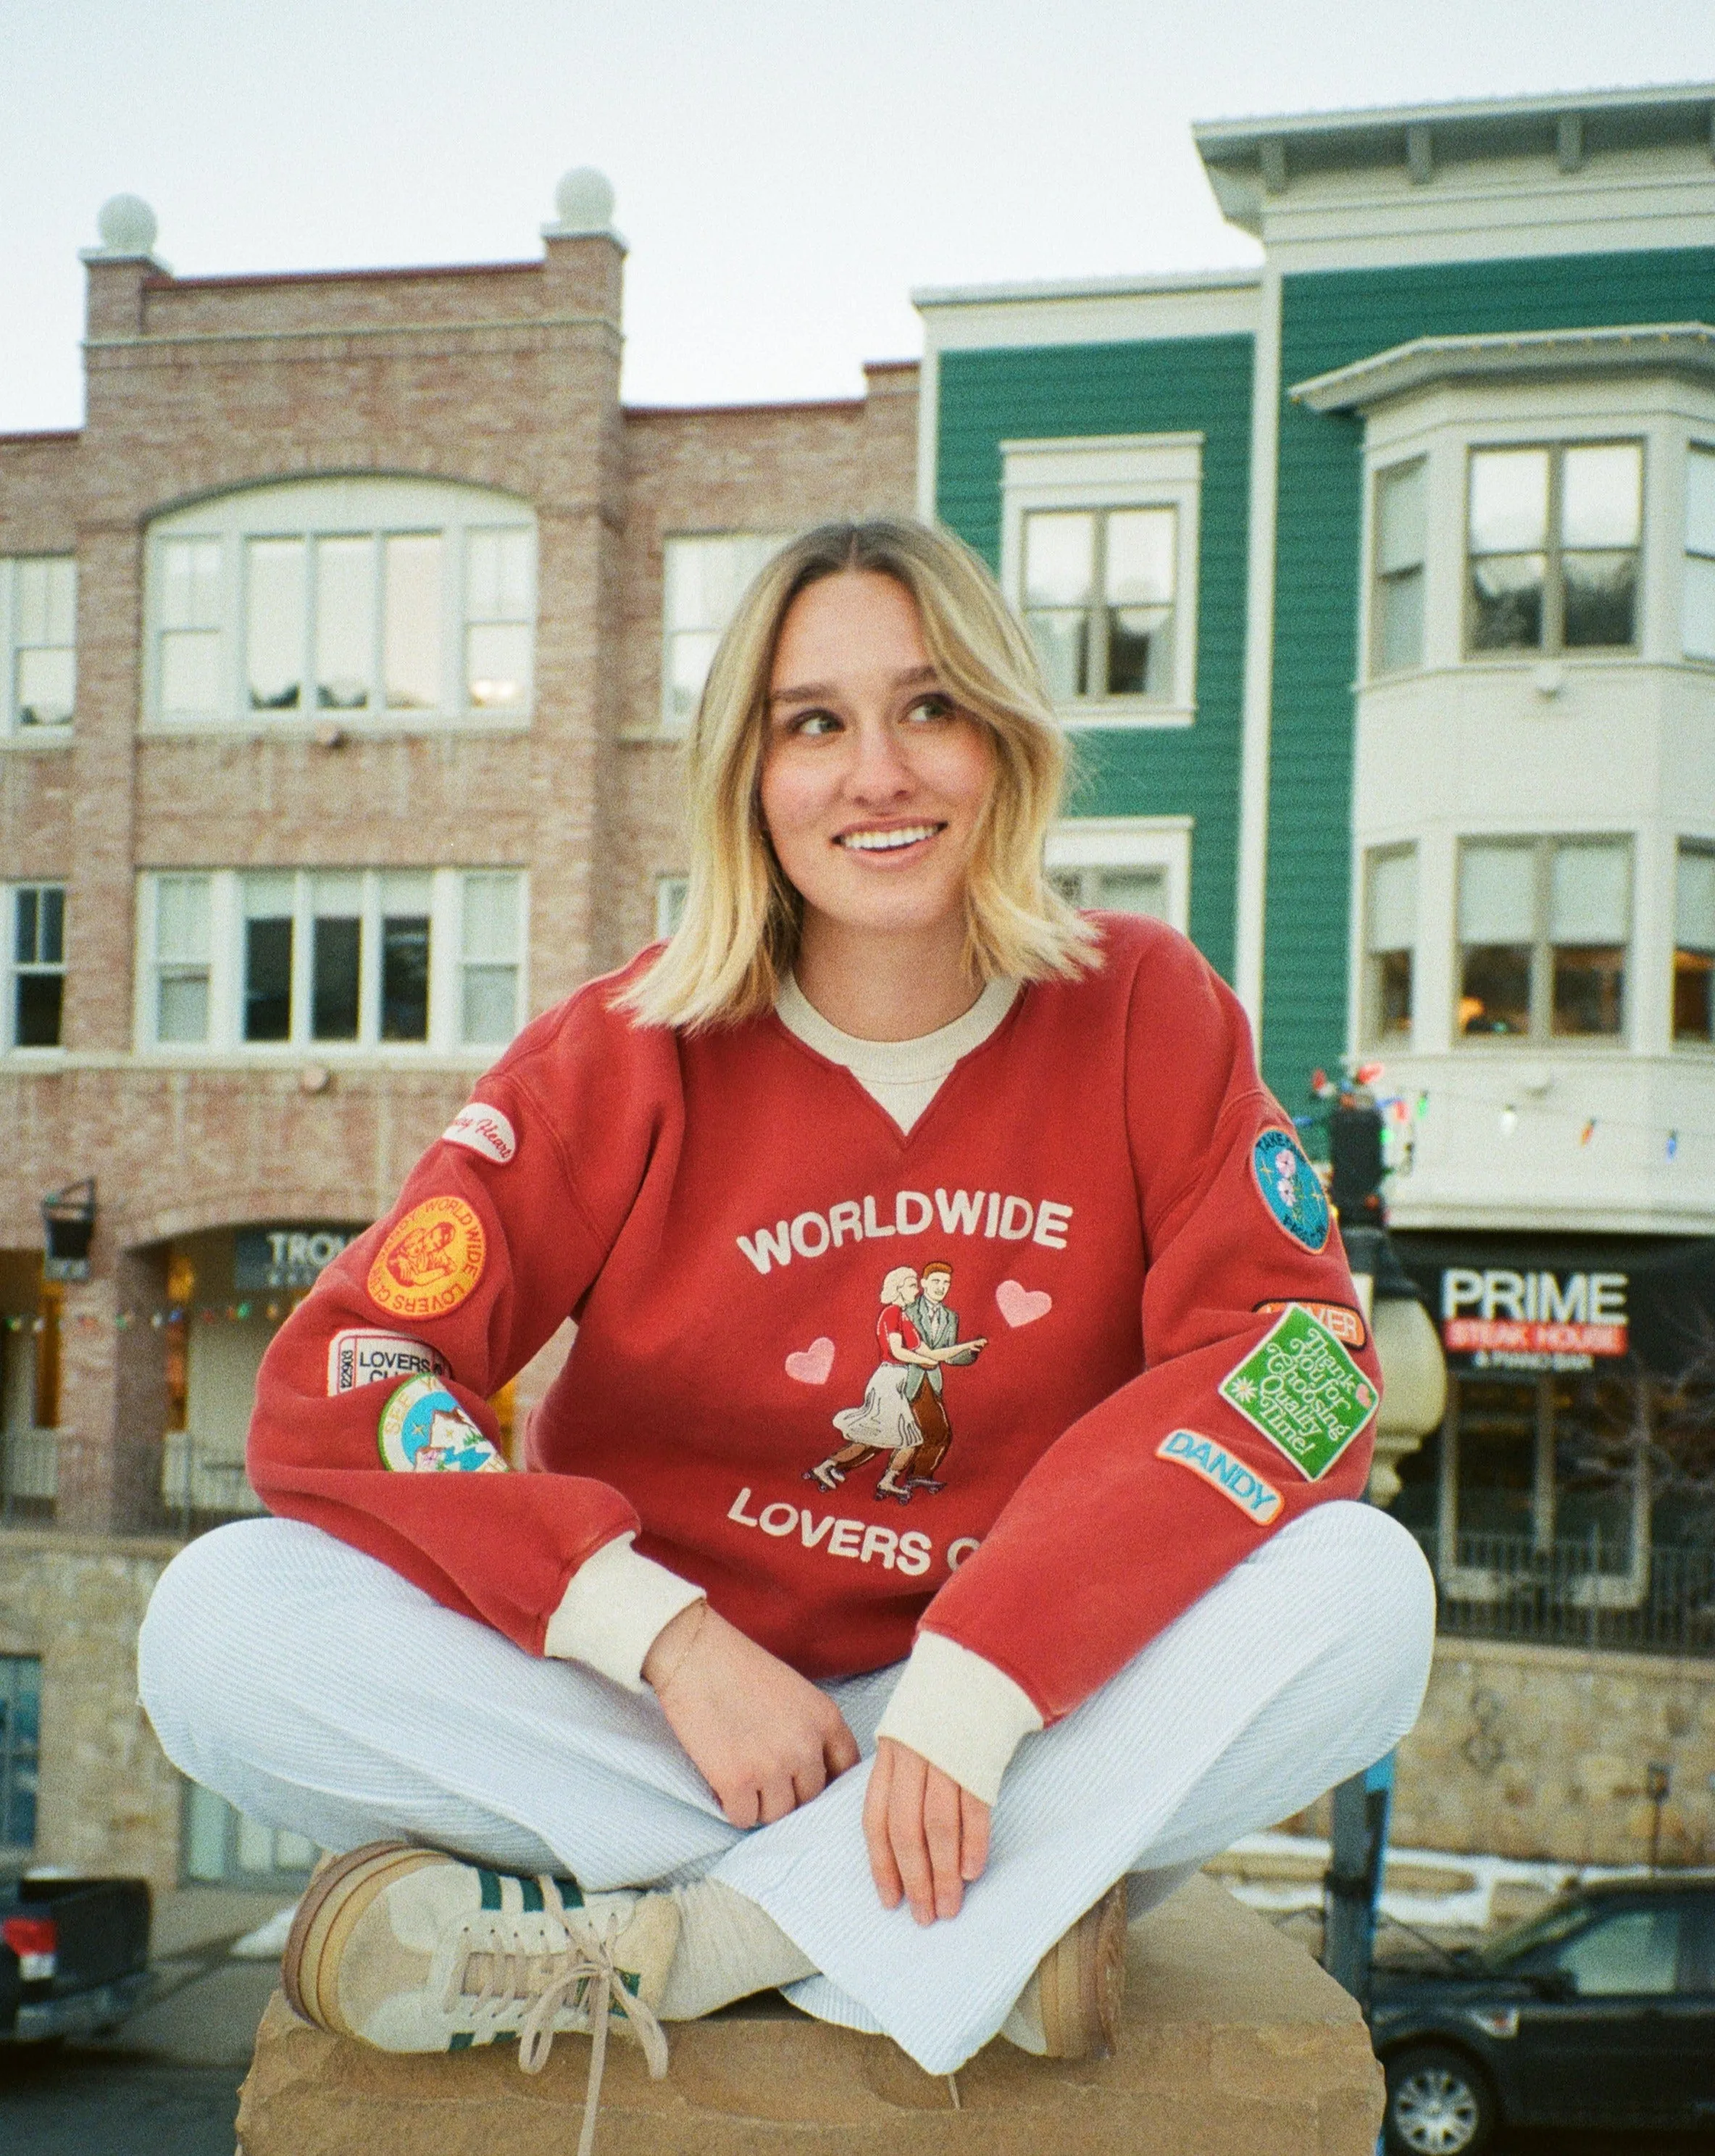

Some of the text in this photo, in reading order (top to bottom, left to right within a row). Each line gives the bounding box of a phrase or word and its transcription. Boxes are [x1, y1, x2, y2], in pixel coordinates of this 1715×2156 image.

[475, 1118, 512, 1158] Heart
[736, 1188, 1073, 1275] WORLDWIDE
[392, 1282, 465, 1313] LOVERS
[1440, 1269, 1629, 1325] PRIME
[359, 1351, 430, 1373] LOVERS
[1267, 1342, 1350, 1441] Choosing
[1290, 1339, 1351, 1410] You for
[1304, 1328, 1356, 1395] Thank
[383, 1390, 410, 1435] SEE
[1259, 1395, 1316, 1456] Time!
[1261, 1376, 1323, 1438] Quality
[1164, 1431, 1277, 1510] DANDY
[727, 1487, 932, 1576] LOVERS
